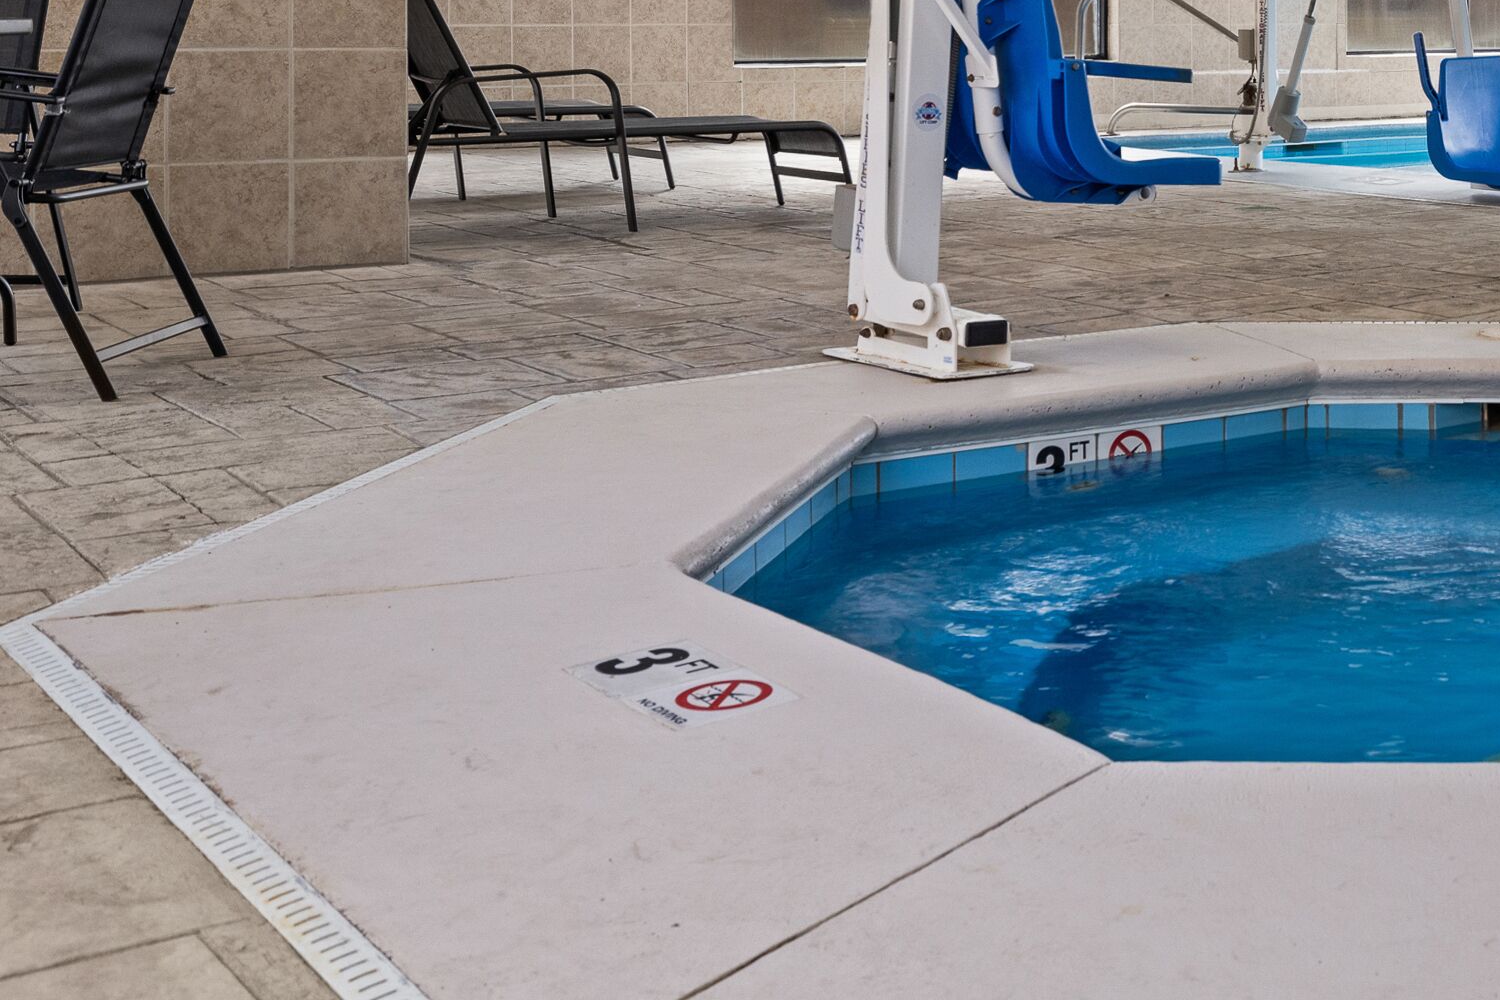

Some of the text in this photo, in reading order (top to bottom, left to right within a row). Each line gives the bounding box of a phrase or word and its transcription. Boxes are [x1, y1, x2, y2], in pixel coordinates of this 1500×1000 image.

[1069, 440, 1090, 461] FT
[595, 648, 720, 675] 3 FT
[638, 698, 687, 724] NO DIVING
